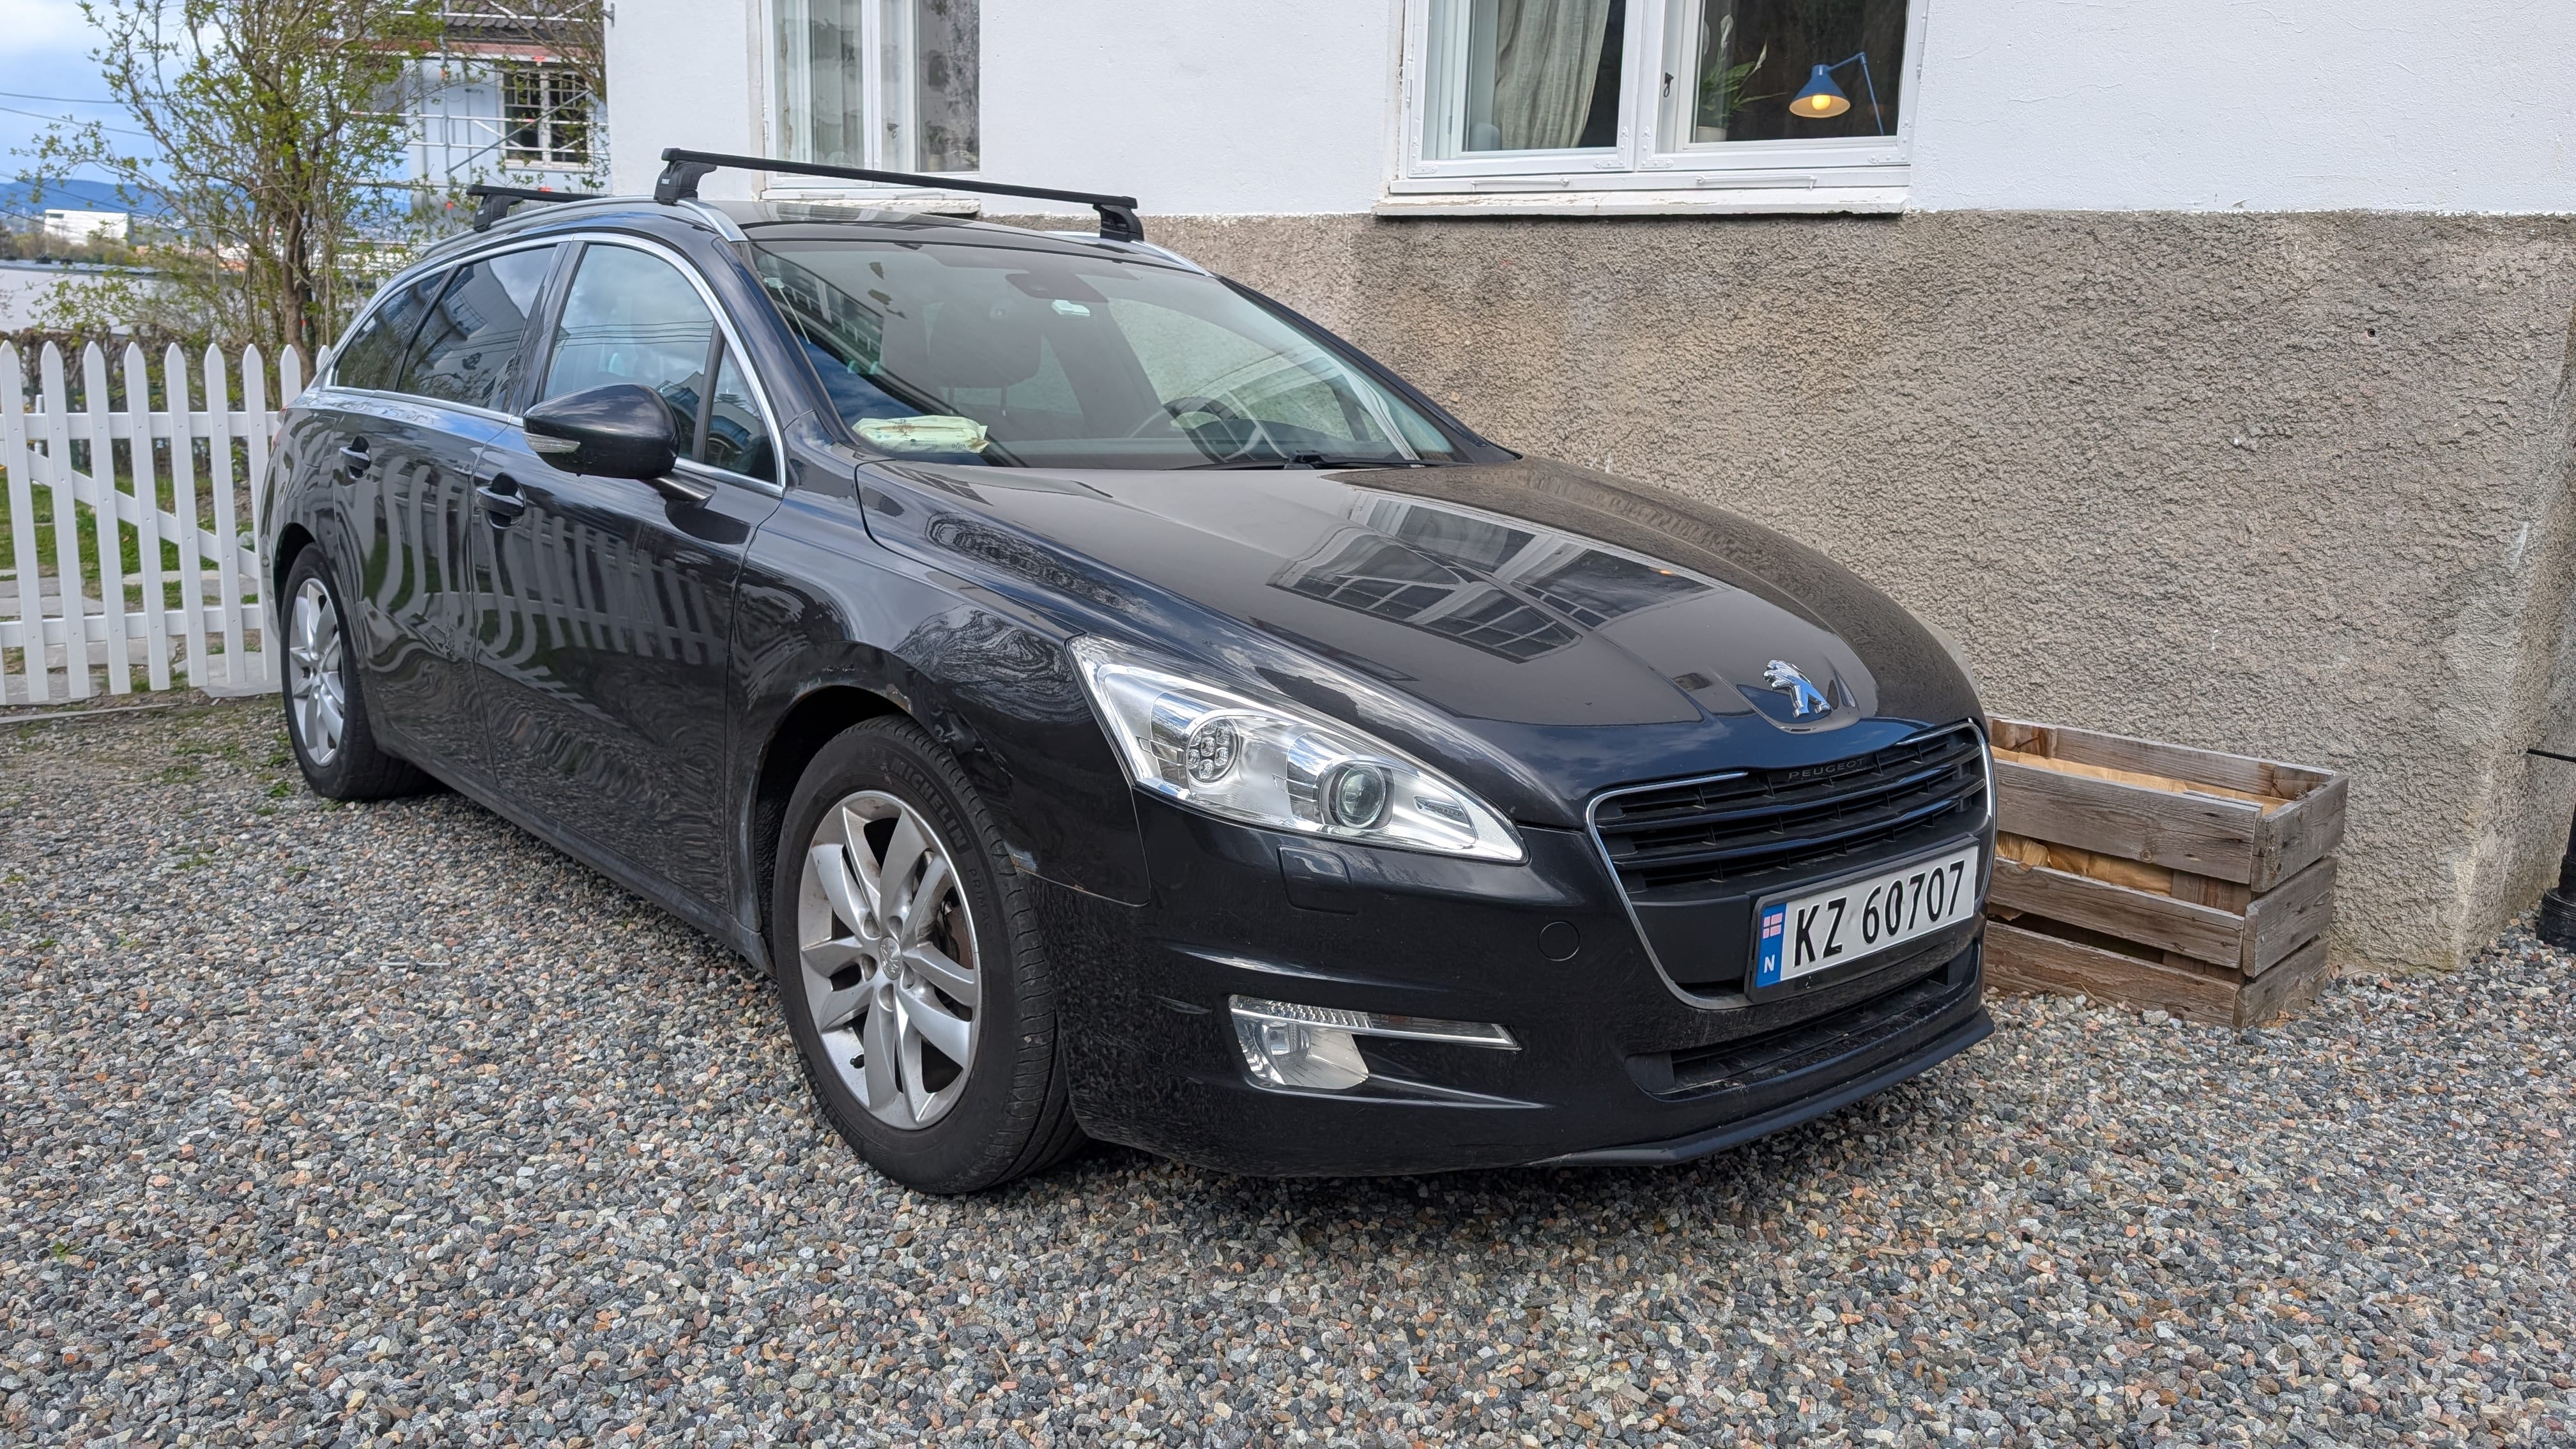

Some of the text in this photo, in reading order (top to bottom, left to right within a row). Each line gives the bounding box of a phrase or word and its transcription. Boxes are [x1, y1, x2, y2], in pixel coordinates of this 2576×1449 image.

[1789, 758, 1866, 779] PEUGEOT
[891, 758, 967, 850] MICHELIN
[1793, 860, 1965, 967] KZ 60707
[1763, 954, 1775, 974] N
